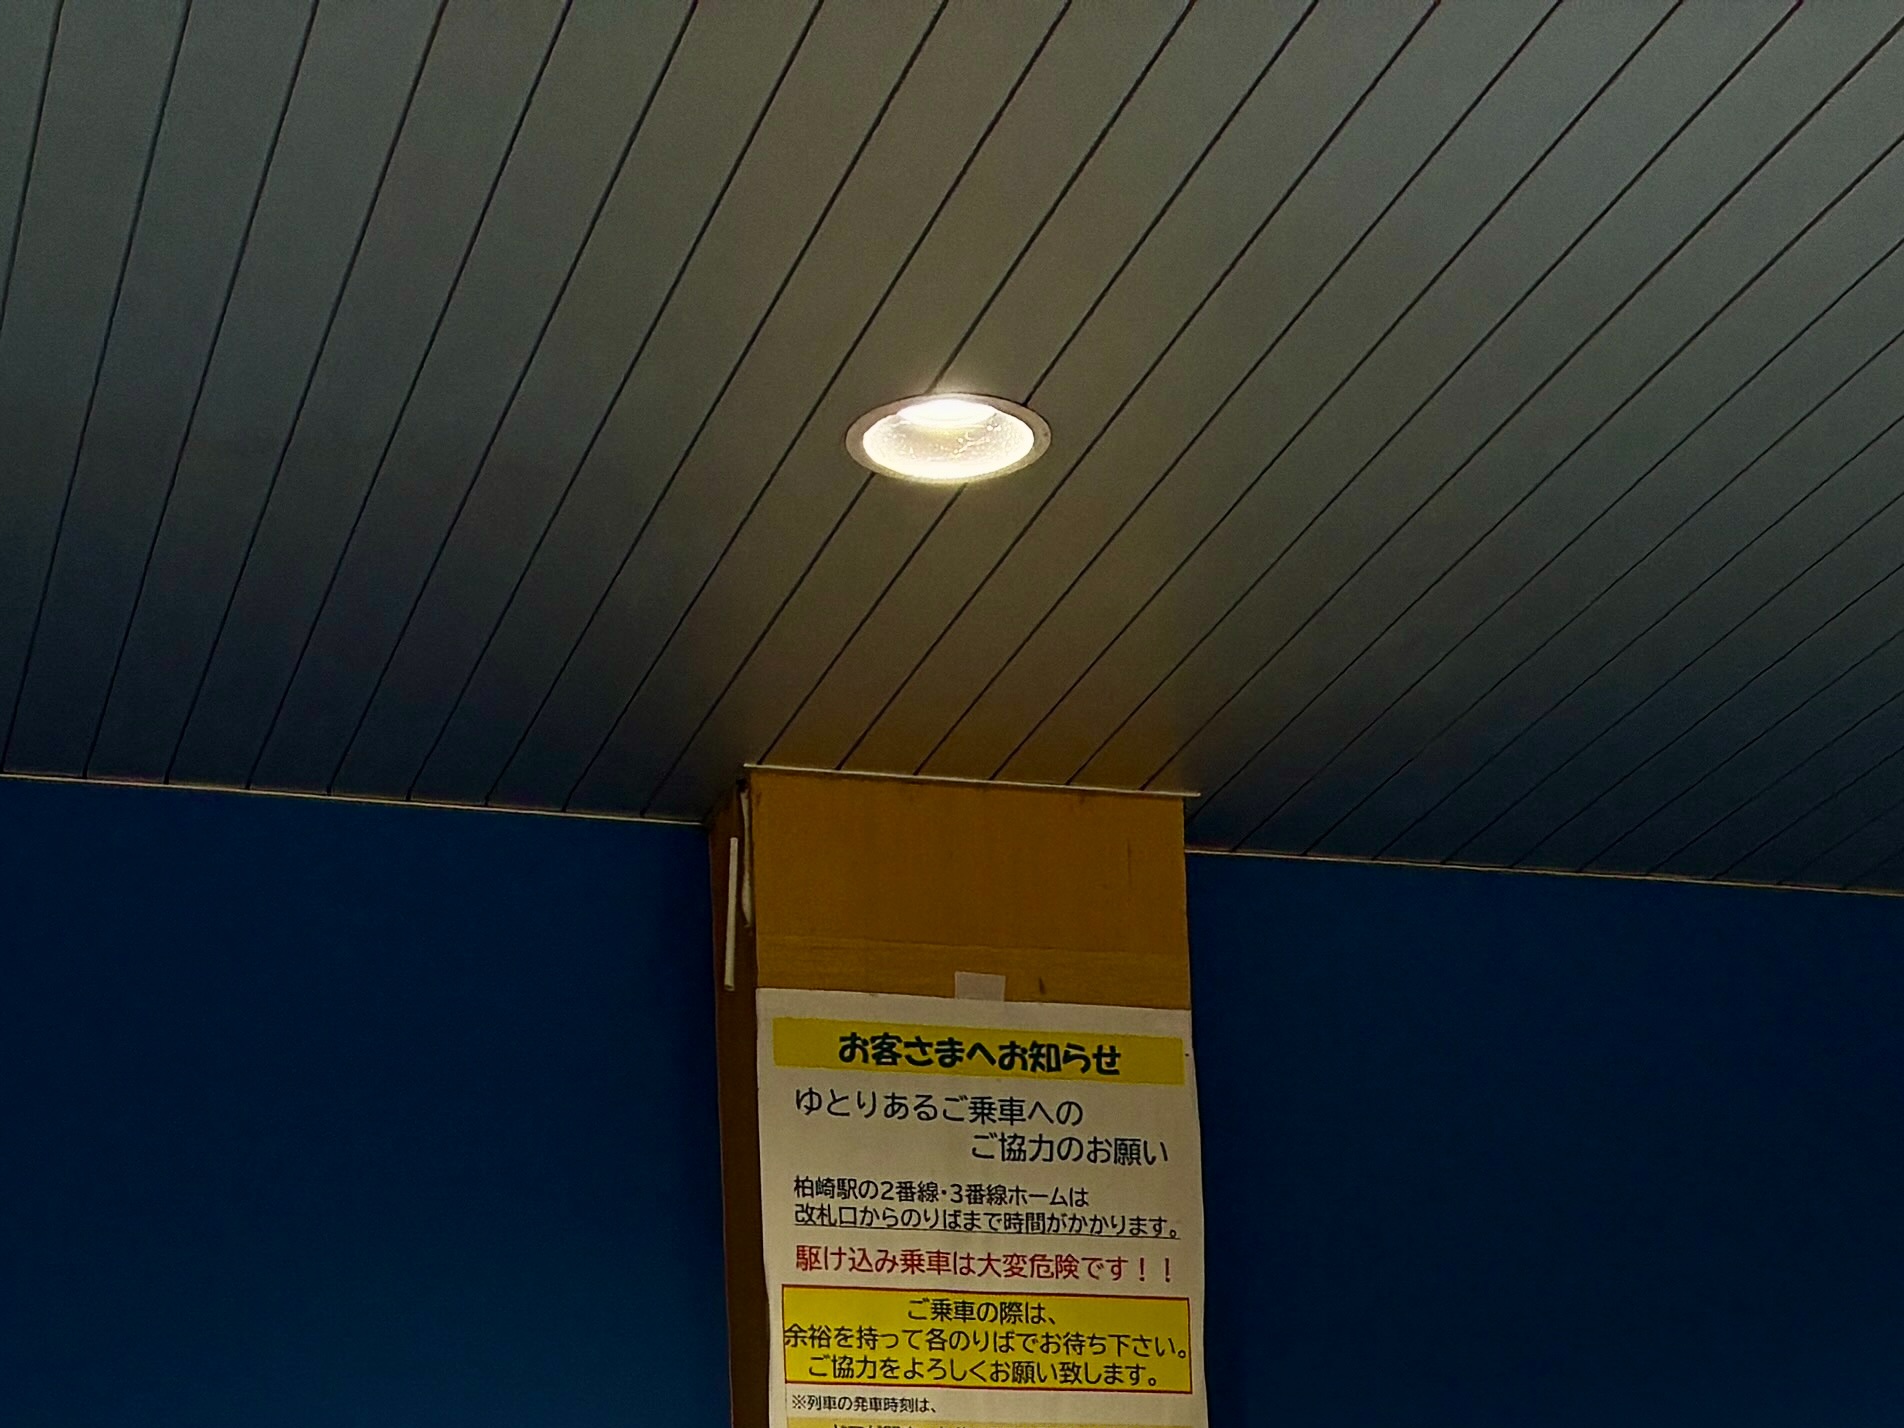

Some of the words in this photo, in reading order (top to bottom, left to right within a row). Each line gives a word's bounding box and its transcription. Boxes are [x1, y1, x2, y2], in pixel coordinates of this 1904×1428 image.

[838, 1031, 1122, 1076] お客さまへお知らせ
[795, 1086, 1084, 1127] ゆとりあるご乗車への
[971, 1132, 1169, 1167] ご協力のお願い
[793, 1175, 1089, 1208] 柏崎駅の2番線・3番線ホームは
[794, 1204, 1180, 1239] 改札口からのりばまで時間がかかります。
[795, 1244, 1173, 1283] 駆け込み乗車は大変危険です！！
[907, 1297, 1058, 1326] ご乗車の際は、
[783, 1324, 1188, 1359] 余裕を持って各のりばでお待ち下さい。
[808, 1354, 1159, 1388] ご協力をよろしくお願い致します。
[791, 1393, 938, 1415] ※列車の発車時刻は、
